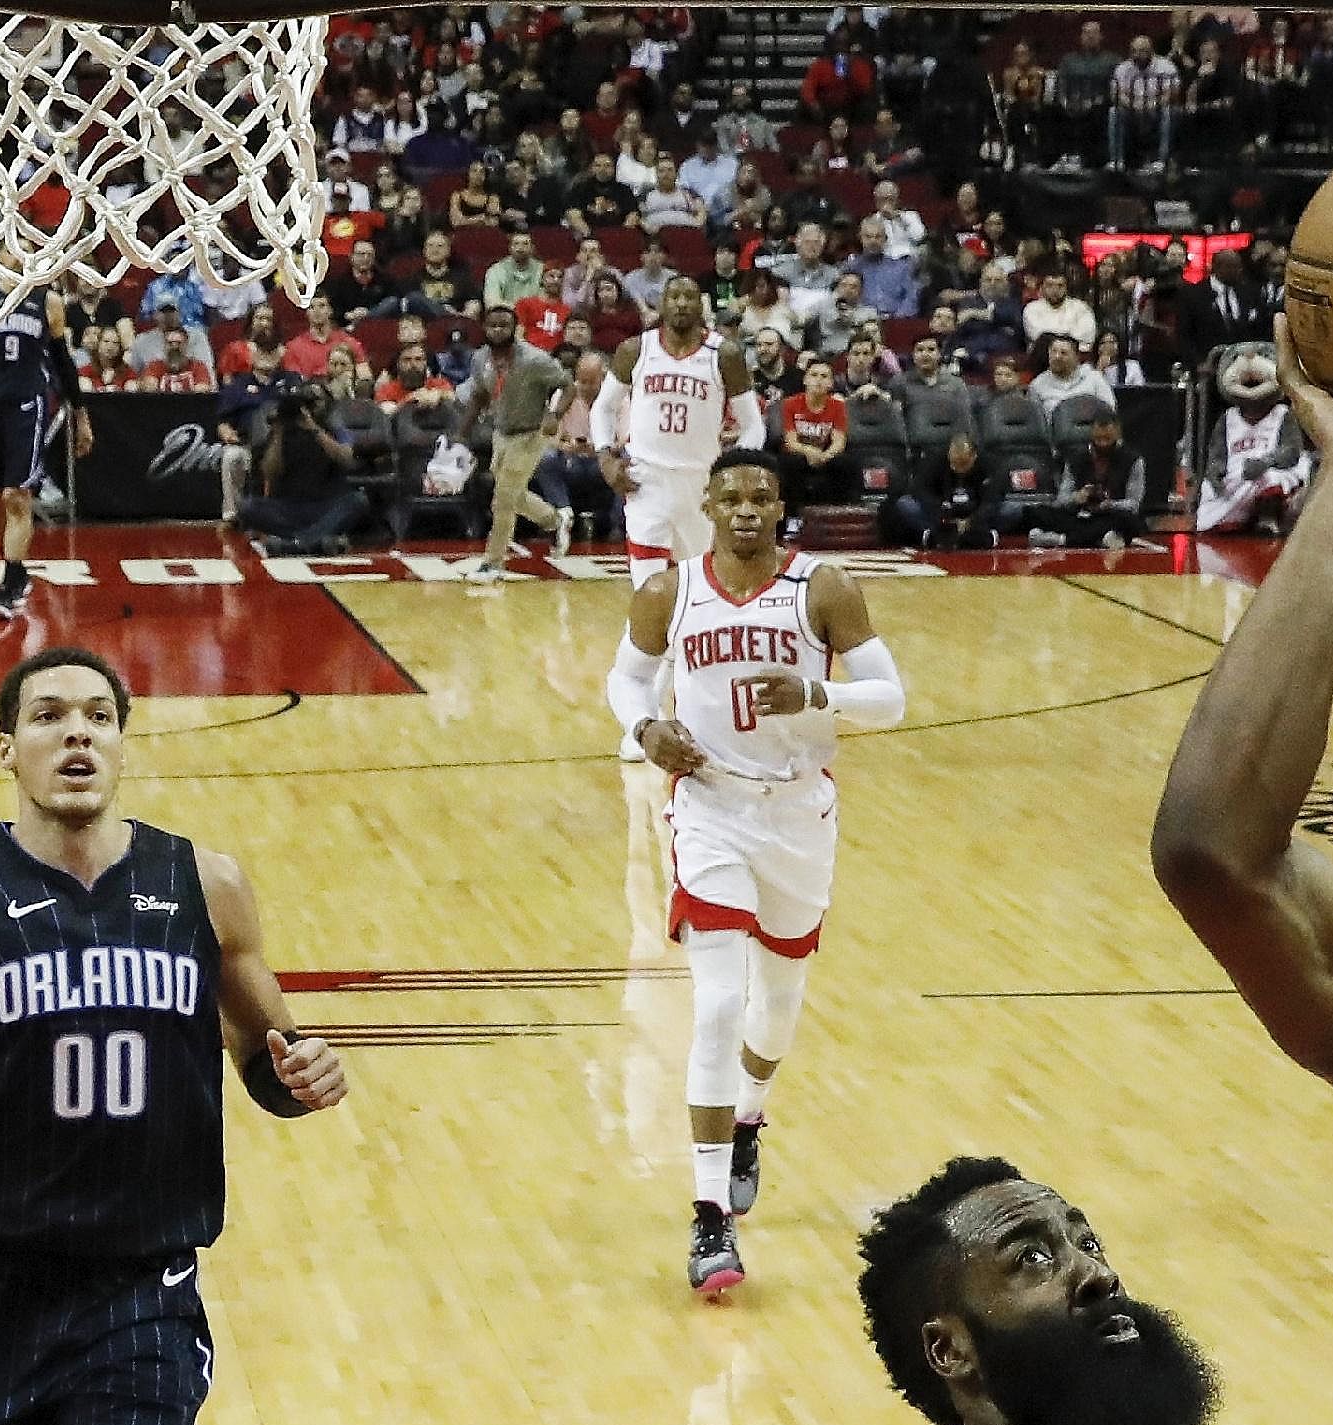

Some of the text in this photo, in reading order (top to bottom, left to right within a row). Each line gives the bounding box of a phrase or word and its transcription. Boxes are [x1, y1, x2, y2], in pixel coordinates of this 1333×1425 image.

[4, 335, 20, 361] 9
[659, 402, 687, 433] 33
[683, 625, 799, 672] ROCKETS
[129, 893, 180, 916] Disney
[51, 1030, 148, 1119] 00
